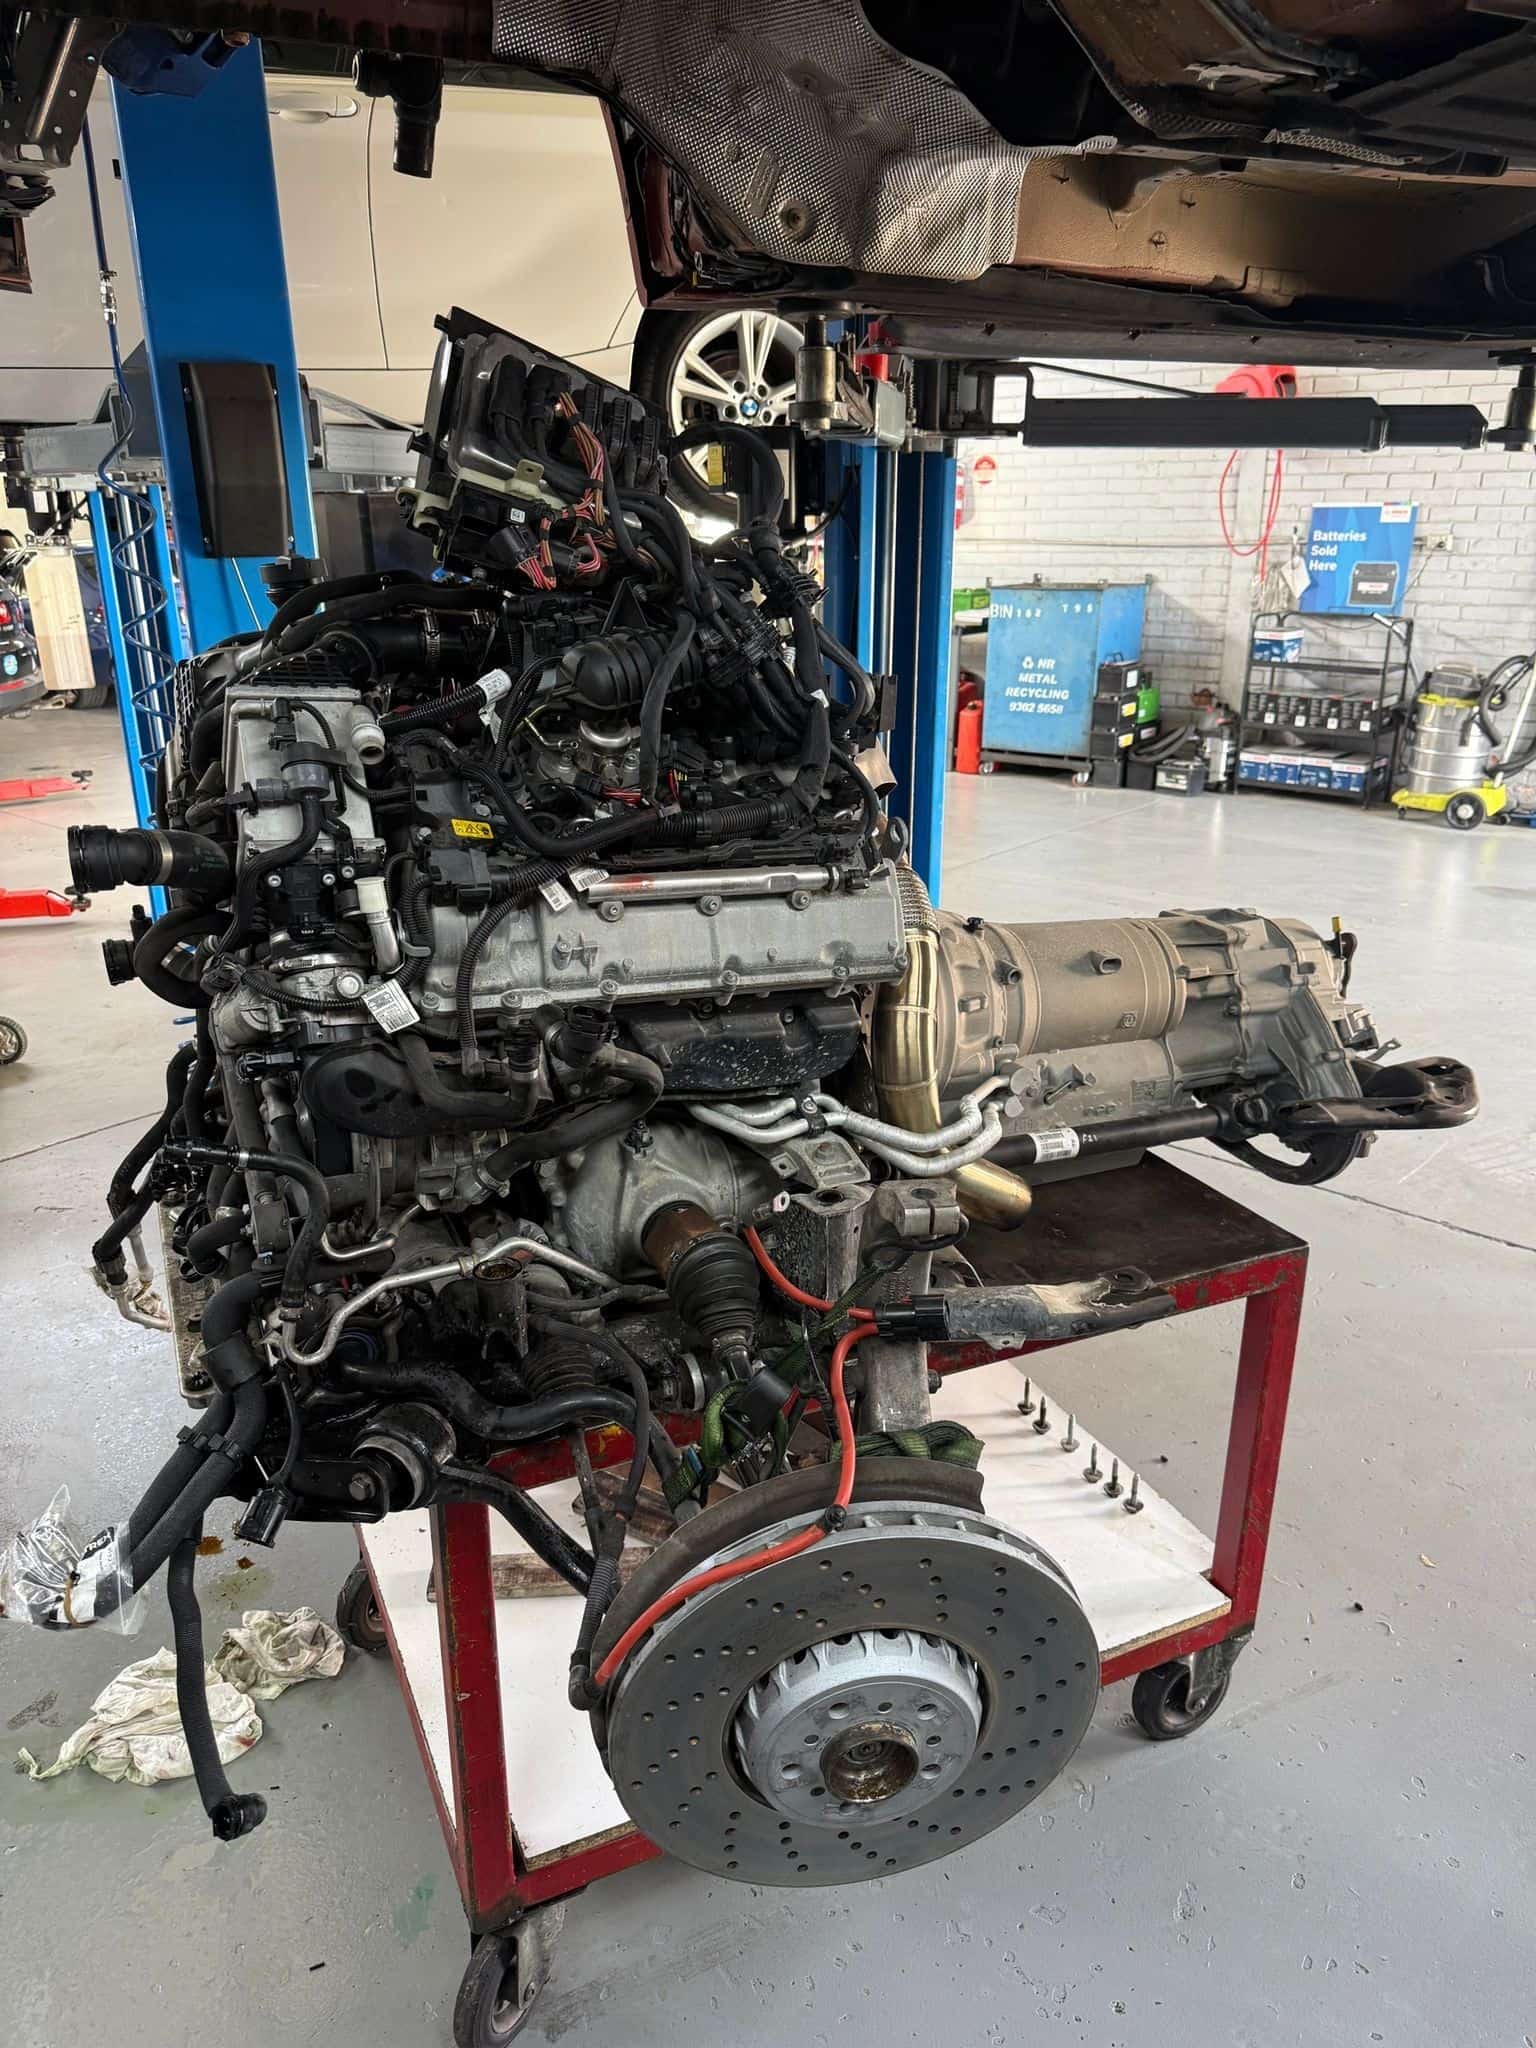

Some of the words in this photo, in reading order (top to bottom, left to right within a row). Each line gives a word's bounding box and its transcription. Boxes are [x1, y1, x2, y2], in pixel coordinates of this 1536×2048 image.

[1313, 530, 1367, 541] Batteries
[1311, 545, 1338, 556] Sold
[1309, 560, 1337, 571] Here
[990, 604, 1013, 619] BIN
[1037, 659, 1056, 669] NR
[1018, 673, 1058, 685] METAL
[1005, 688, 1070, 700] RECYCLING
